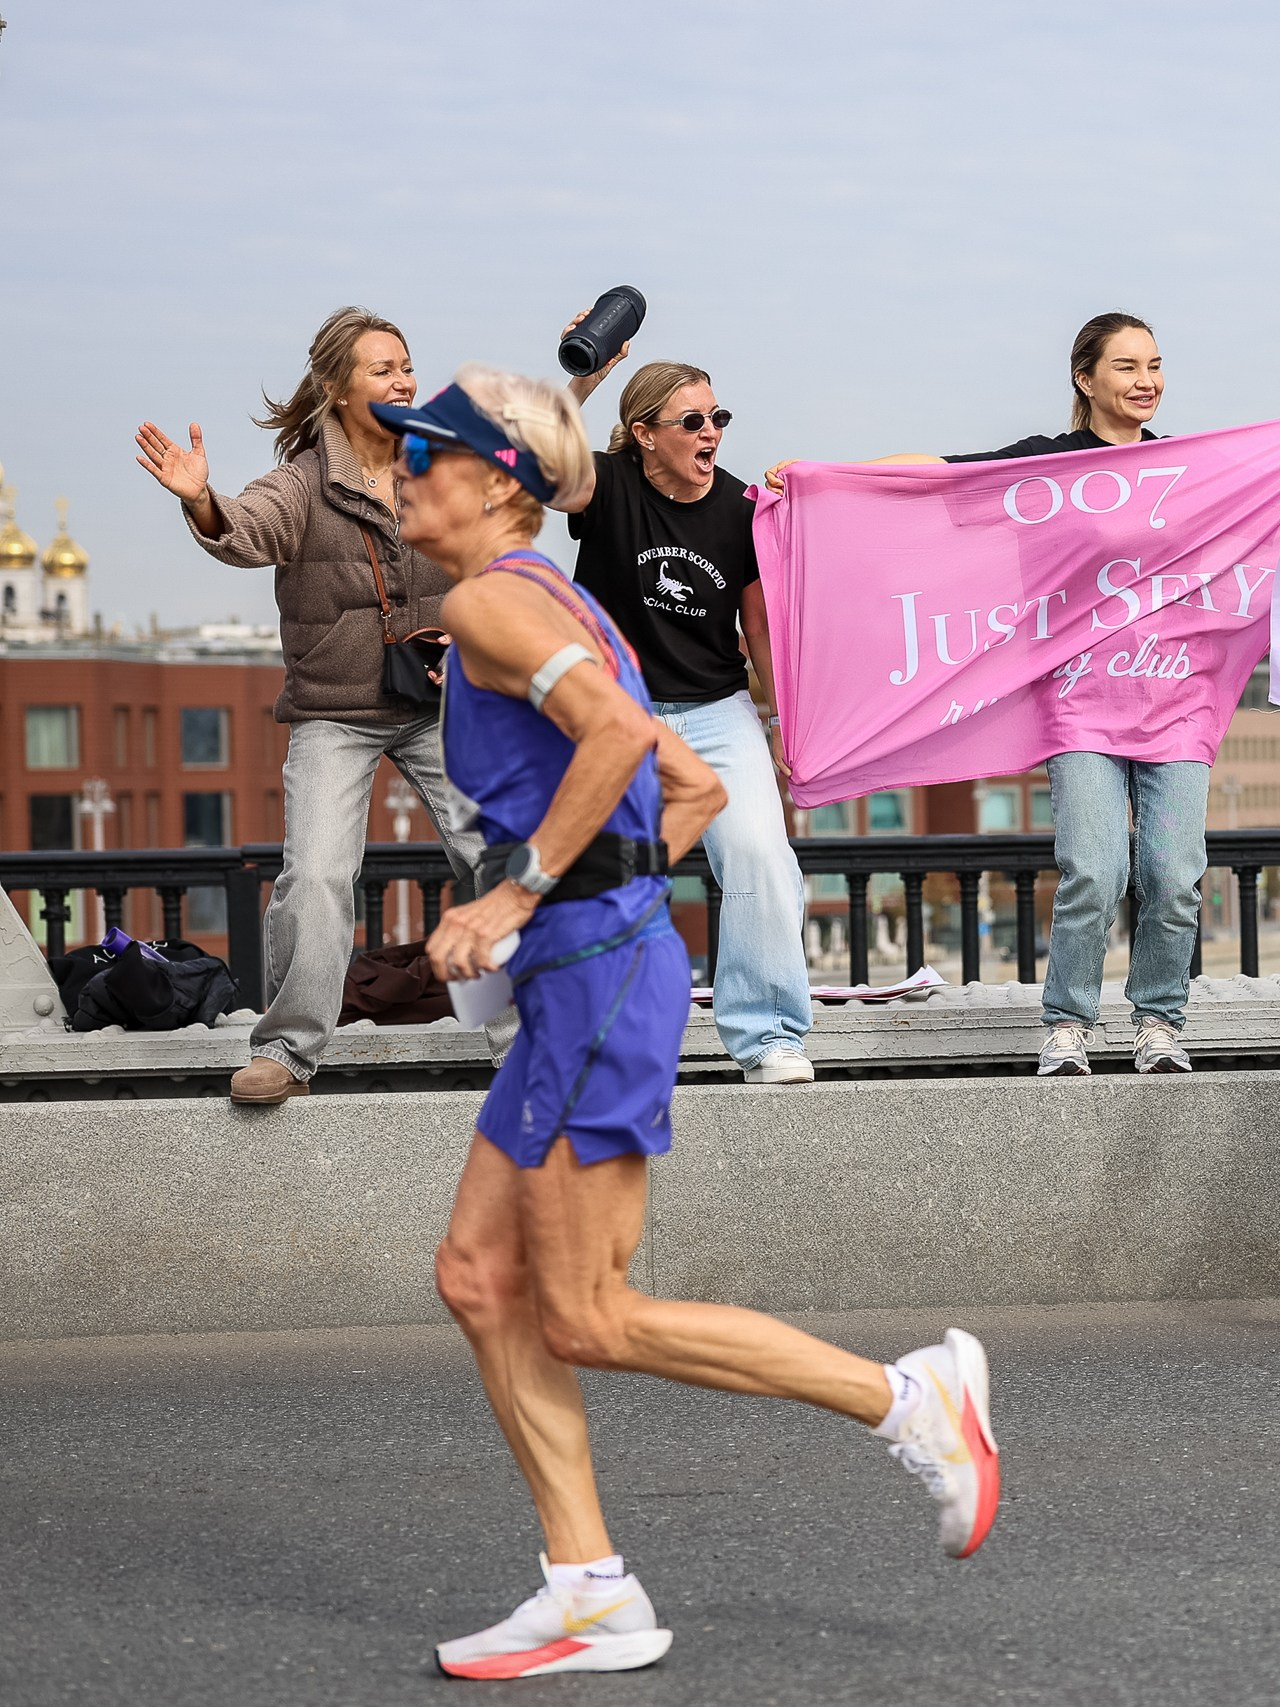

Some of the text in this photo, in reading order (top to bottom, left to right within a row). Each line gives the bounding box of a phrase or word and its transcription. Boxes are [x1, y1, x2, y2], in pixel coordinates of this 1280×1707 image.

[1001, 465, 1189, 530] 007
[637, 546, 727, 590] OVEMBER SCORPIO
[643, 596, 707, 617] CIAL CLUB
[888, 588, 1067, 687] JUST
[1106, 632, 1195, 680] club
